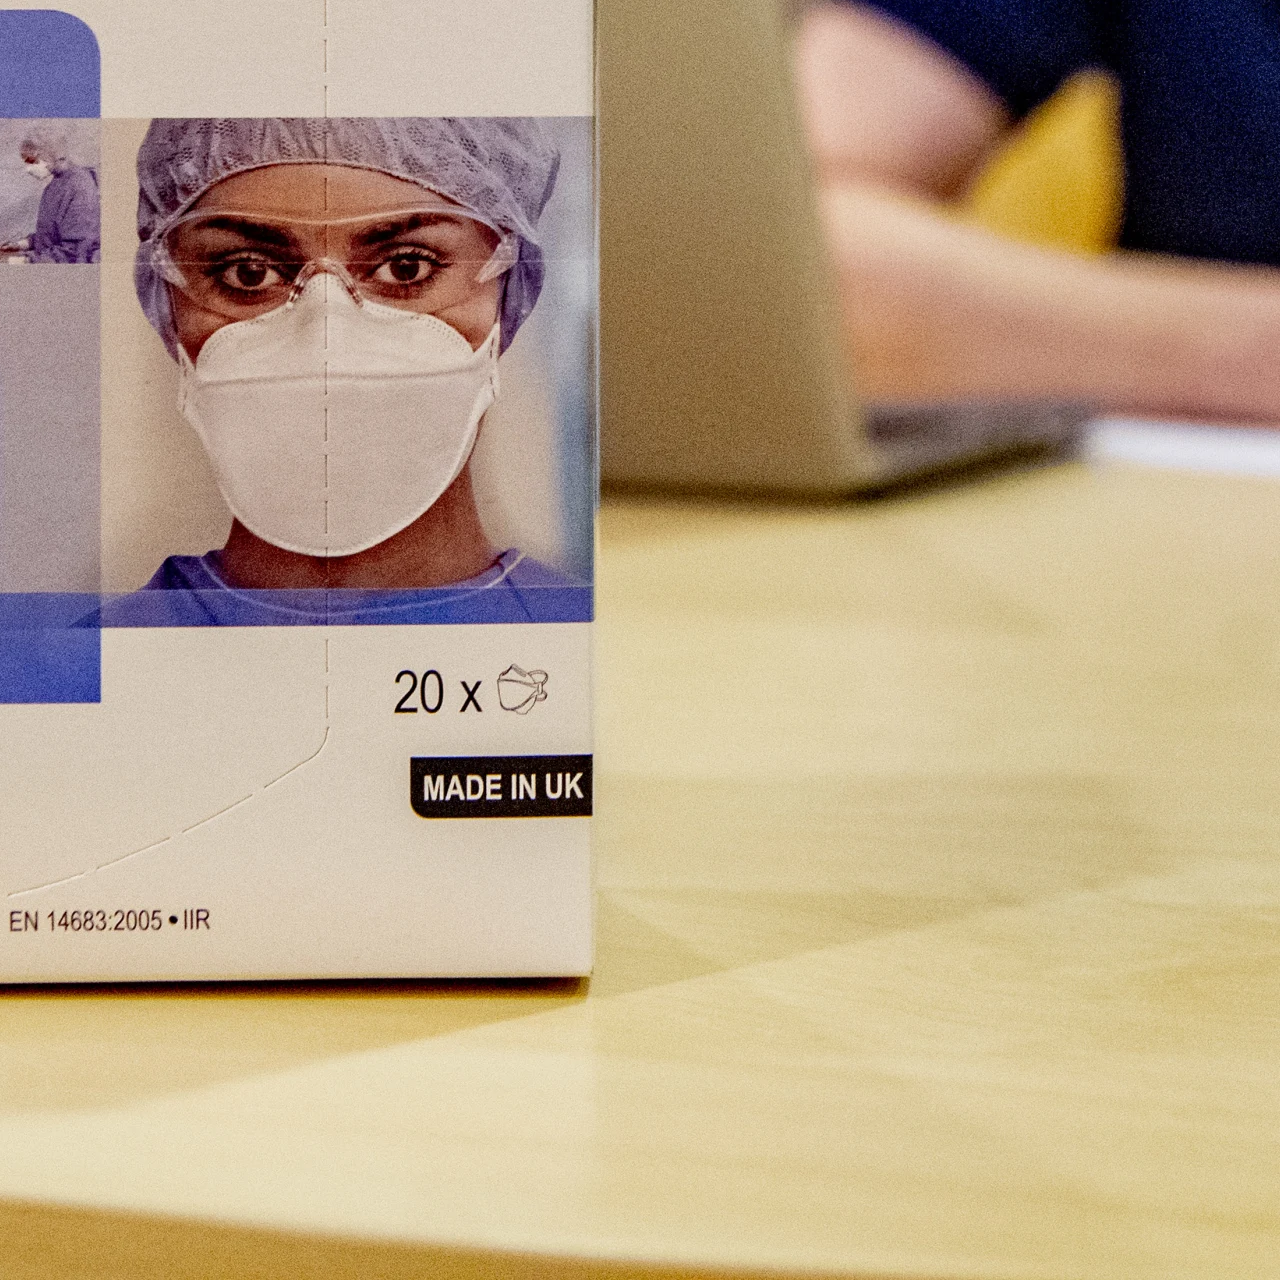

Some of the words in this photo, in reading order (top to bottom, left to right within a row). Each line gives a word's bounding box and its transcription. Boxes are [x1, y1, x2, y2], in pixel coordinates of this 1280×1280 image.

[394, 669, 444, 714] 20
[459, 680, 483, 713] x
[423, 774, 502, 801] MADE
[511, 773, 537, 800] IN
[545, 772, 584, 799] UK
[9, 911, 39, 932] EN
[46, 909, 163, 932] 14683:2005
[183, 908, 211, 930] IIR
